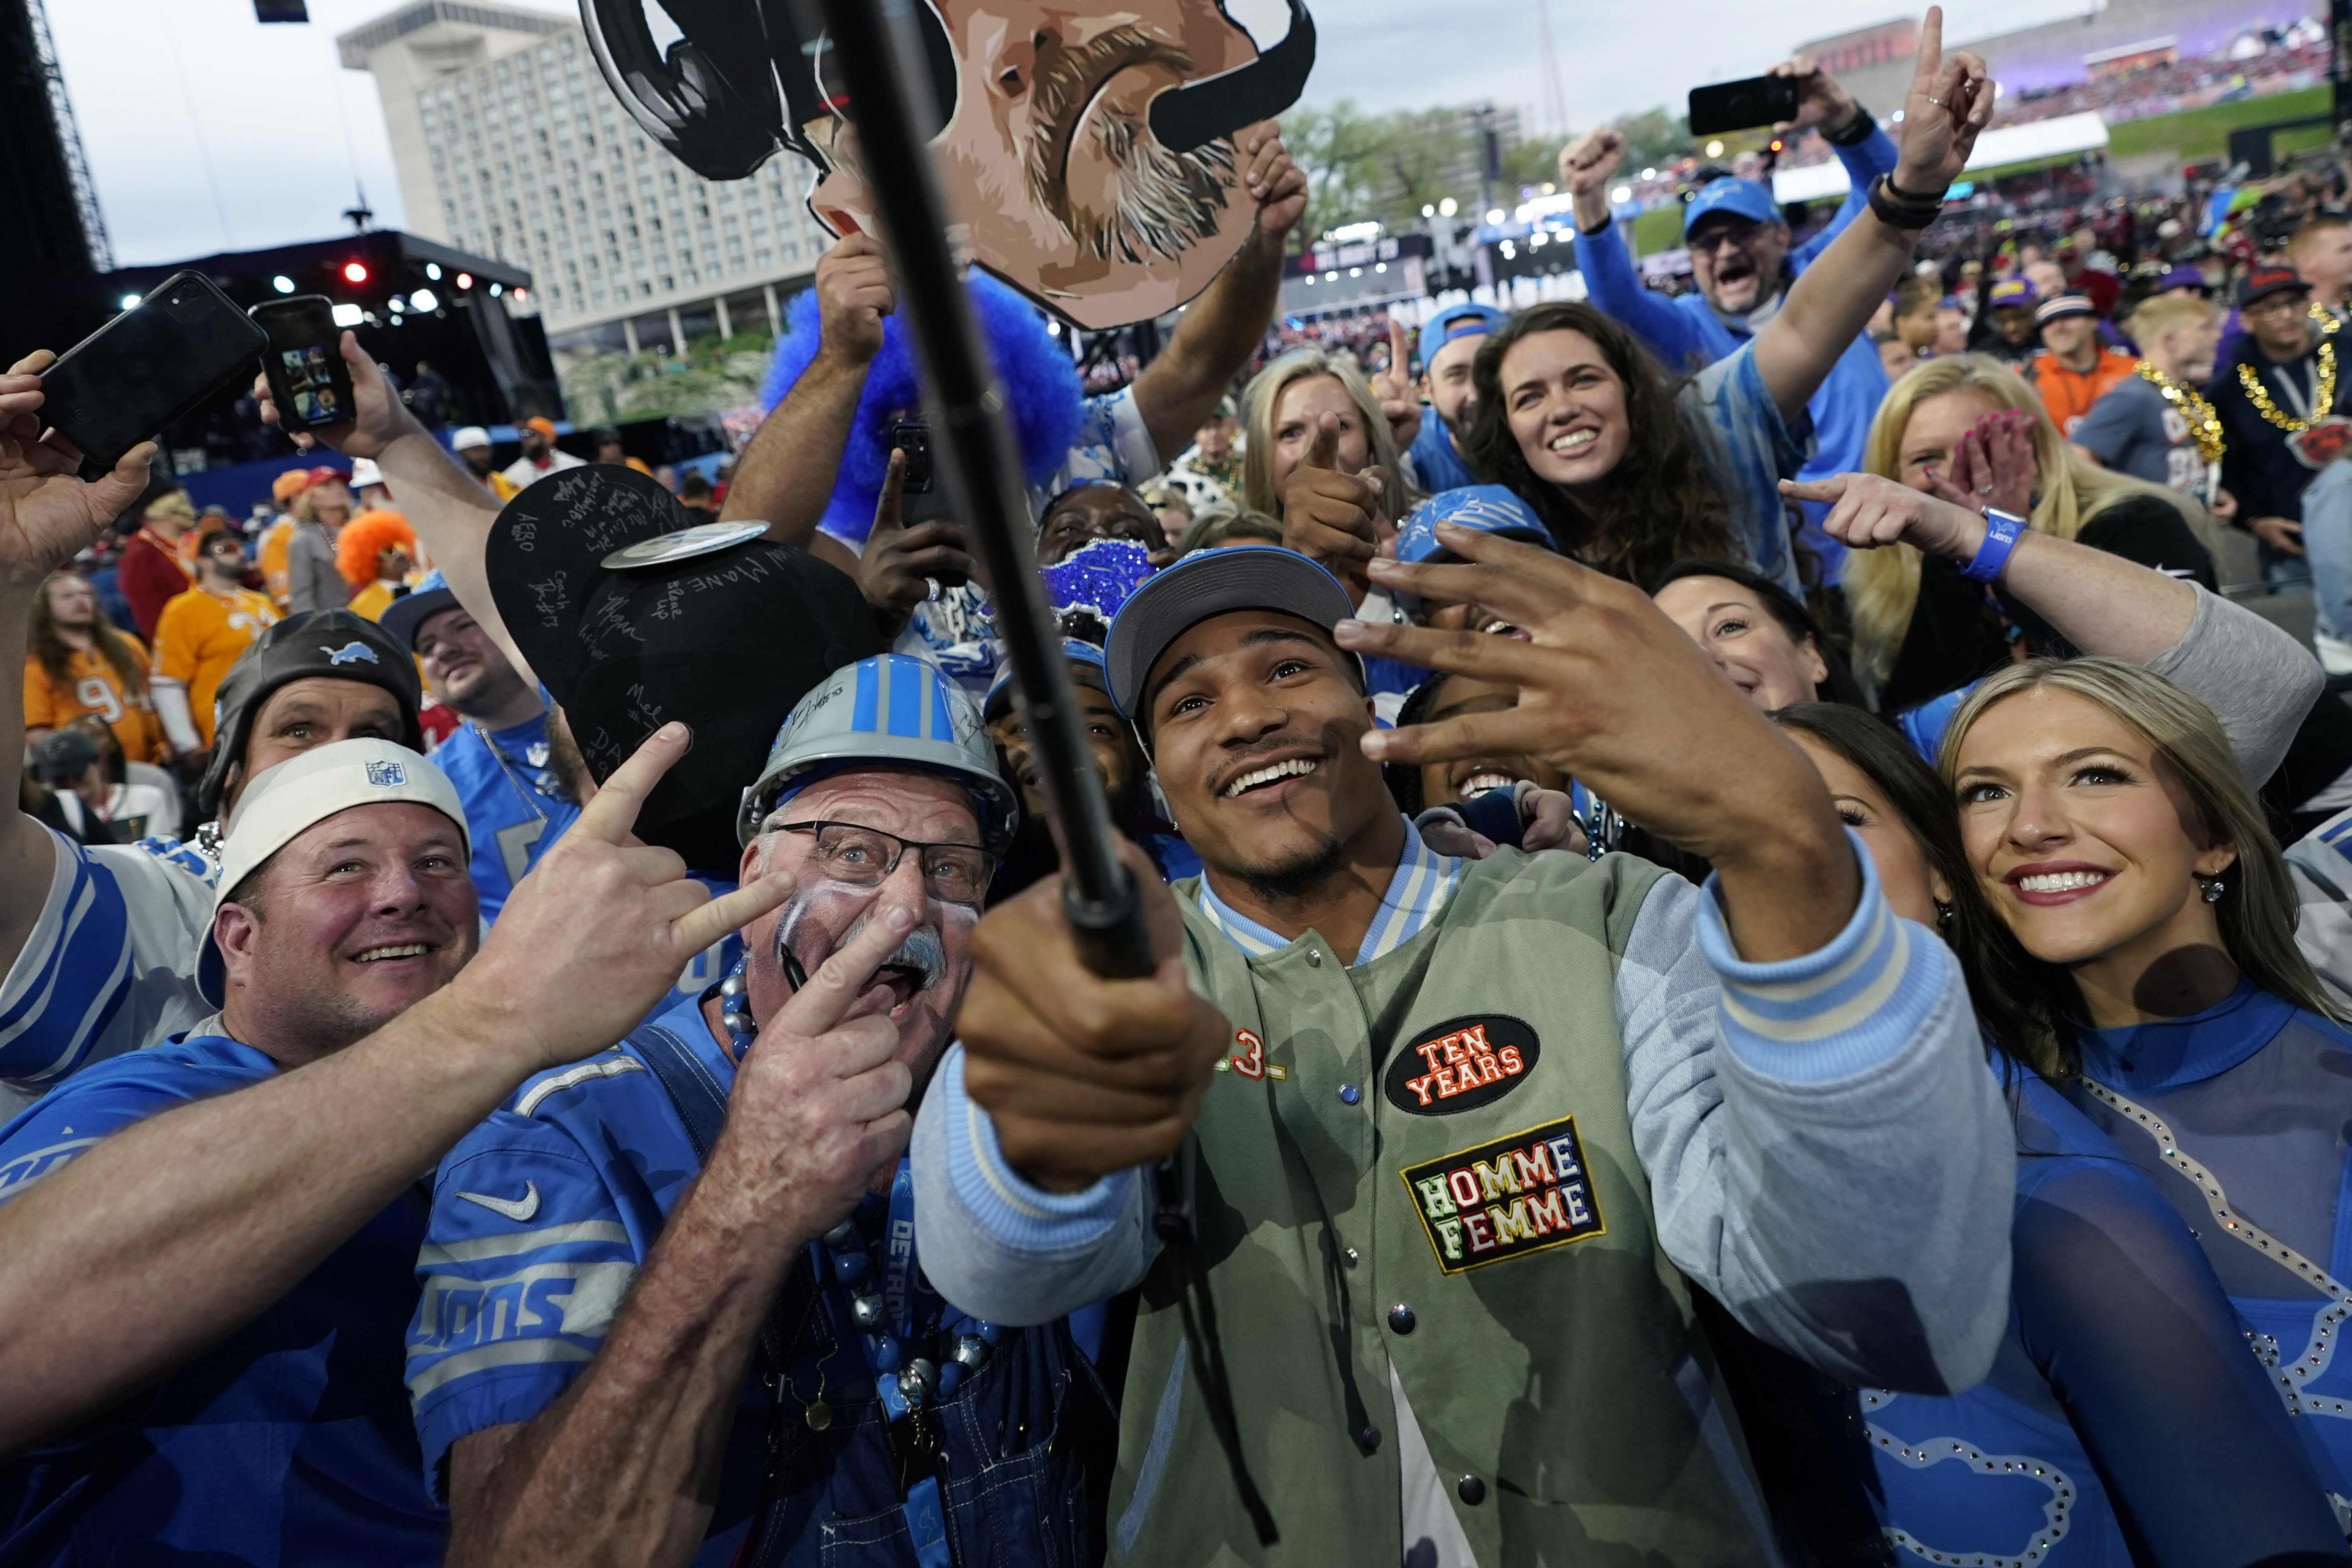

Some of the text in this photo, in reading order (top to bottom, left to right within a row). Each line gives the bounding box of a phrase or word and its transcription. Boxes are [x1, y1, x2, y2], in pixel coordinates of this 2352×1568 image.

[1989, 530, 2013, 543] LIONS
[1406, 1045, 1524, 1105] YEARS
[1416, 1024, 1492, 1071] TEN
[1416, 1133, 1581, 1217] HOMME
[1434, 1179, 1592, 1259] FEMME
